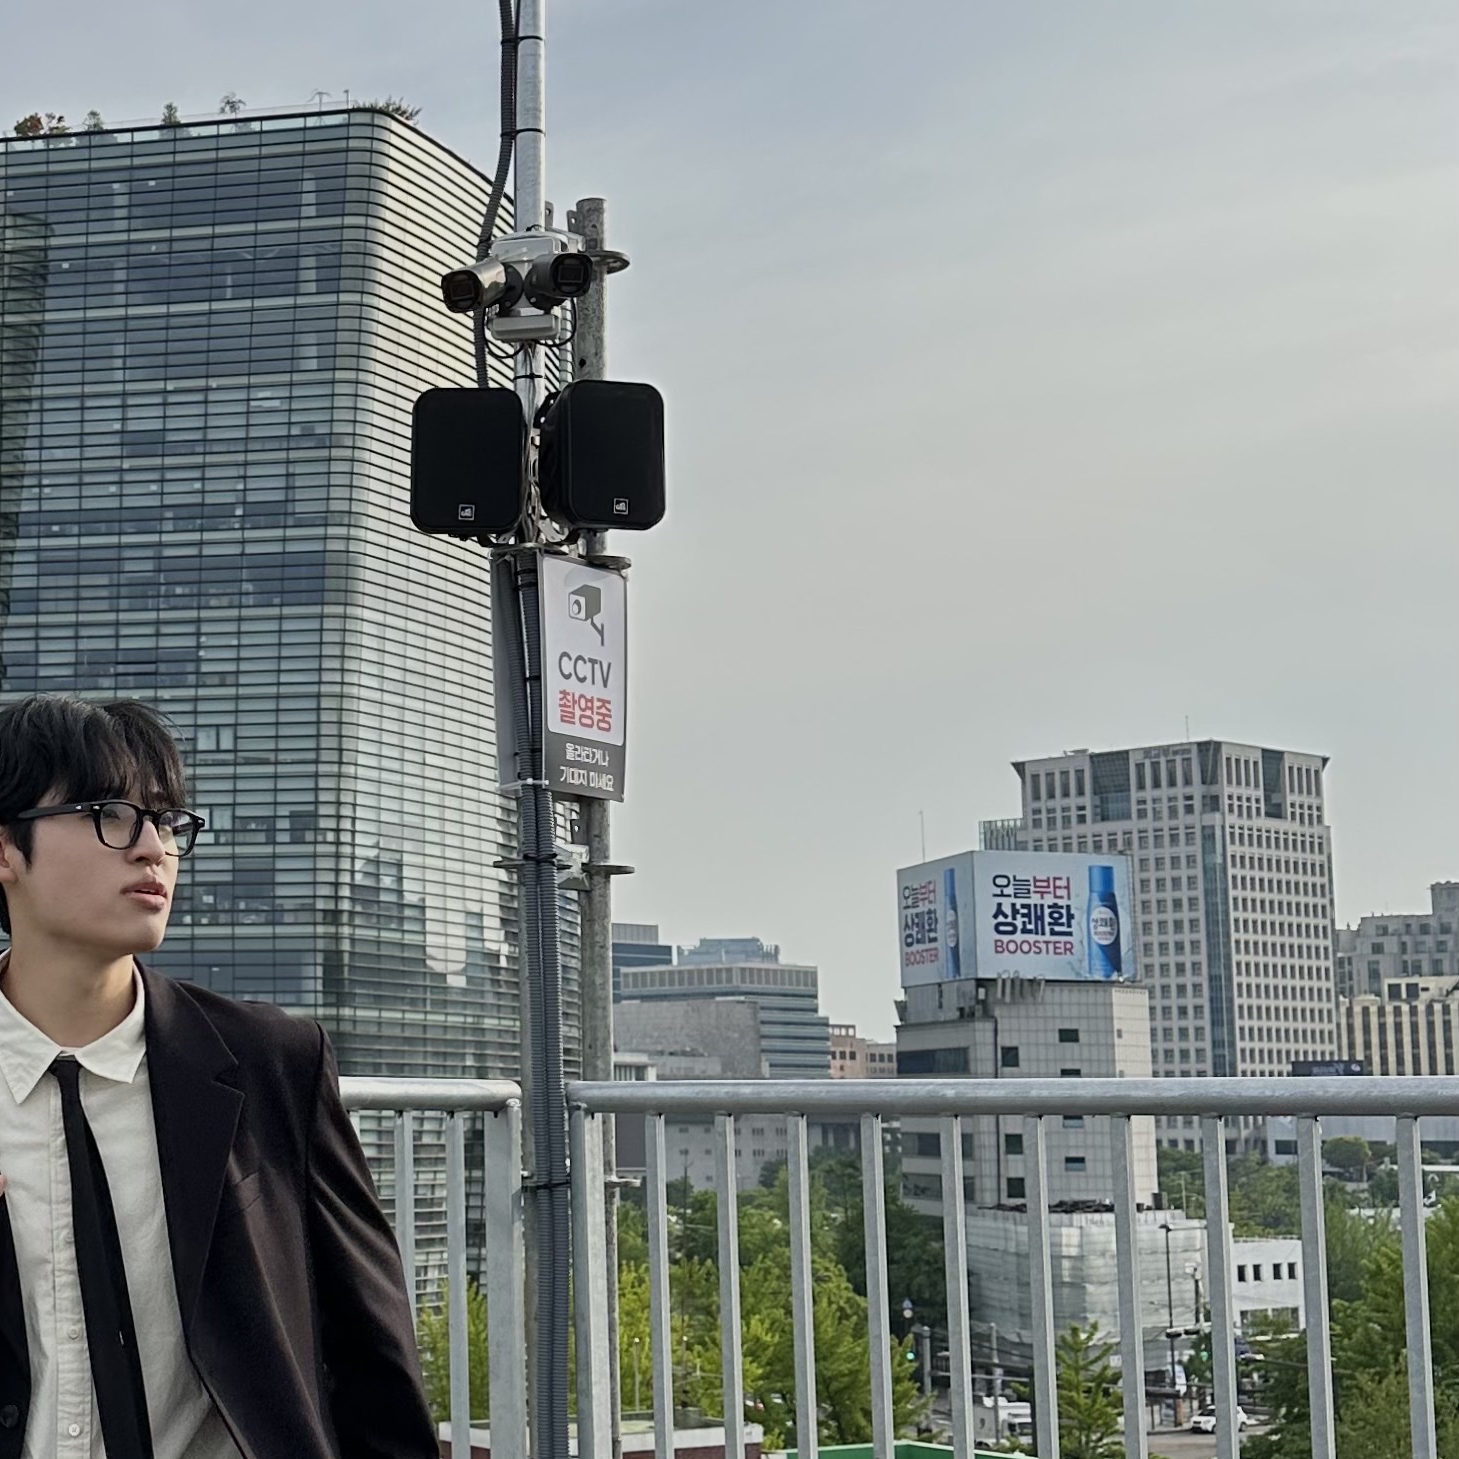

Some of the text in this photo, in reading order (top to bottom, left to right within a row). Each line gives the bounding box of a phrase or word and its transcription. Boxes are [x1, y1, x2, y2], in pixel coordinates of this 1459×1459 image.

[558, 651, 612, 689] CCTV
[558, 689, 613, 733] 촬영중
[565, 742, 610, 768] 올라타거나
[559, 766, 615, 792] 기대지 마세요
[902, 880, 937, 910] 오늘부터
[992, 874, 1071, 901] 오늘부터
[903, 908, 939, 948] 상쾌환
[991, 902, 1075, 937] 상쾌환
[904, 947, 939, 967] BOOSTER
[994, 939, 1075, 956] BOOSTER
